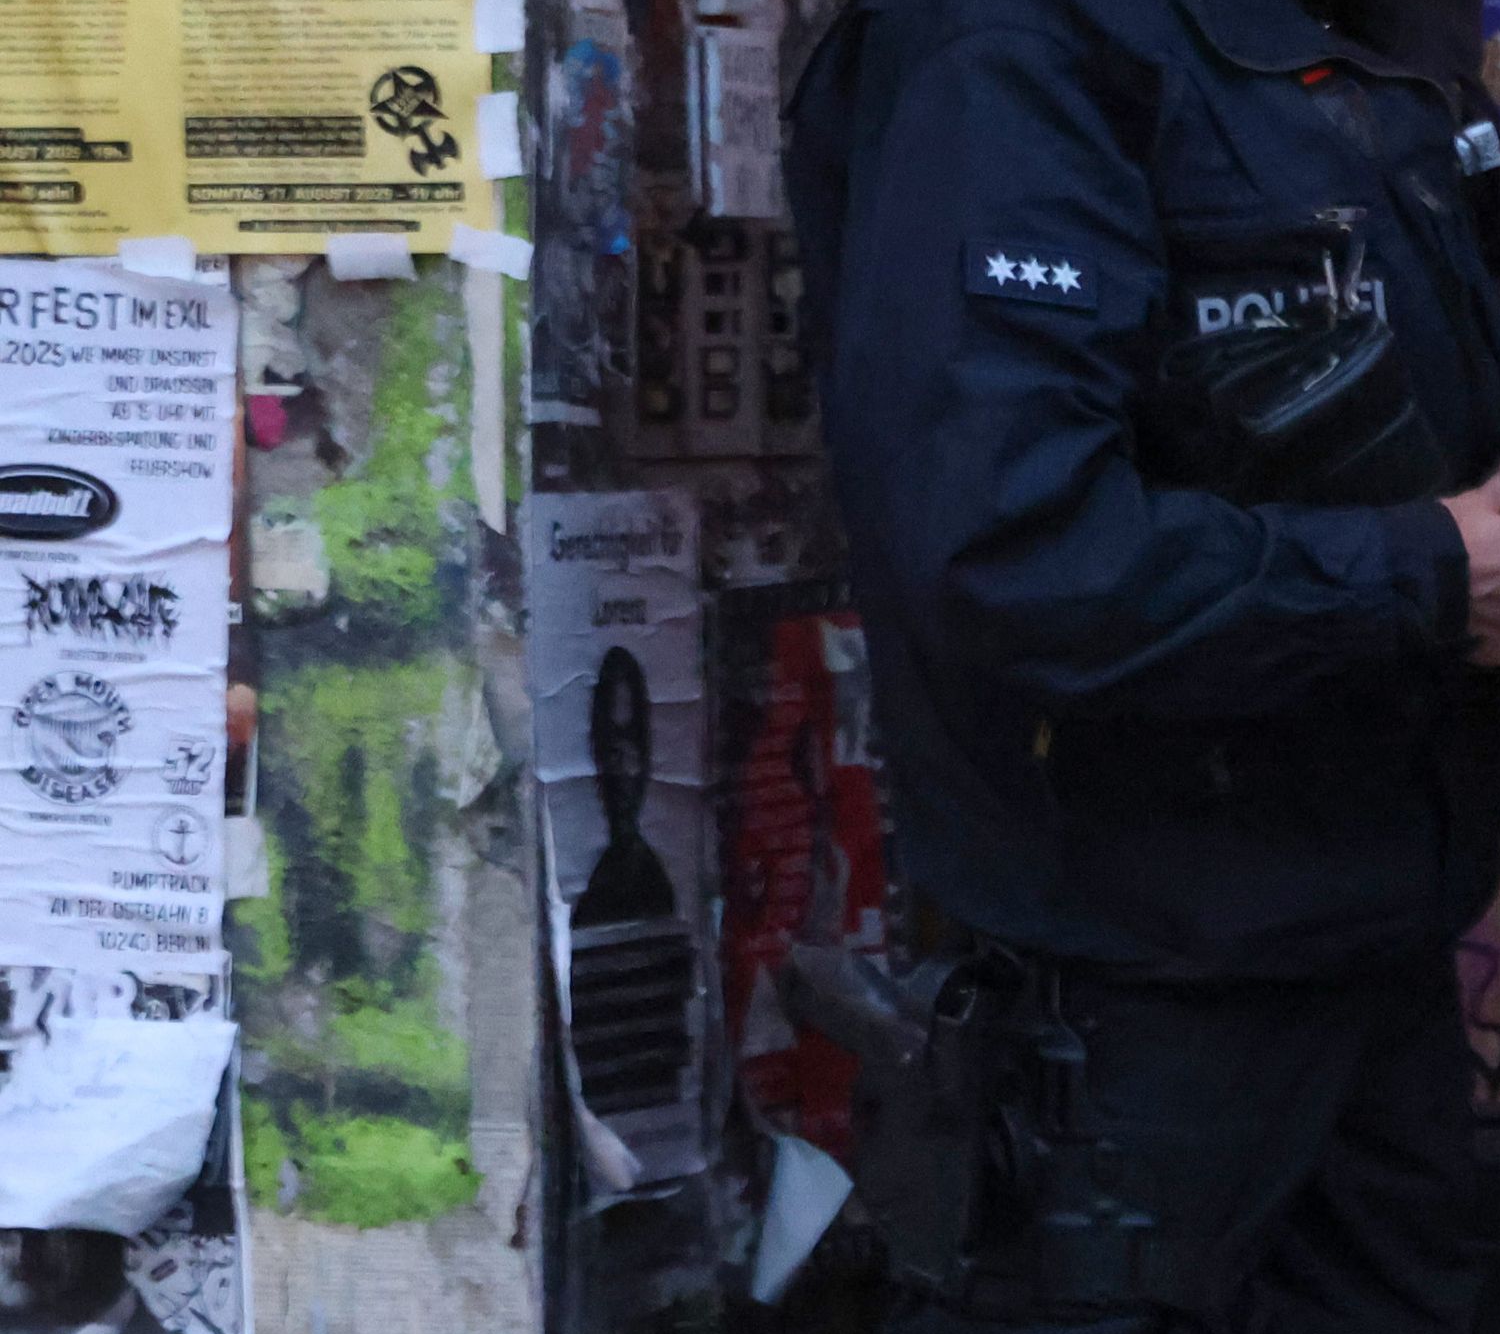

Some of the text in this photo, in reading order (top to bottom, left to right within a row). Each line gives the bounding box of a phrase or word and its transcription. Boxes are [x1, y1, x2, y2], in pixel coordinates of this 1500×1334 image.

[30, 287, 124, 331] FEST
[131, 297, 158, 328] IM
[1198, 279, 1389, 334] POEI
[112, 870, 211, 895] PUMPTRACK
